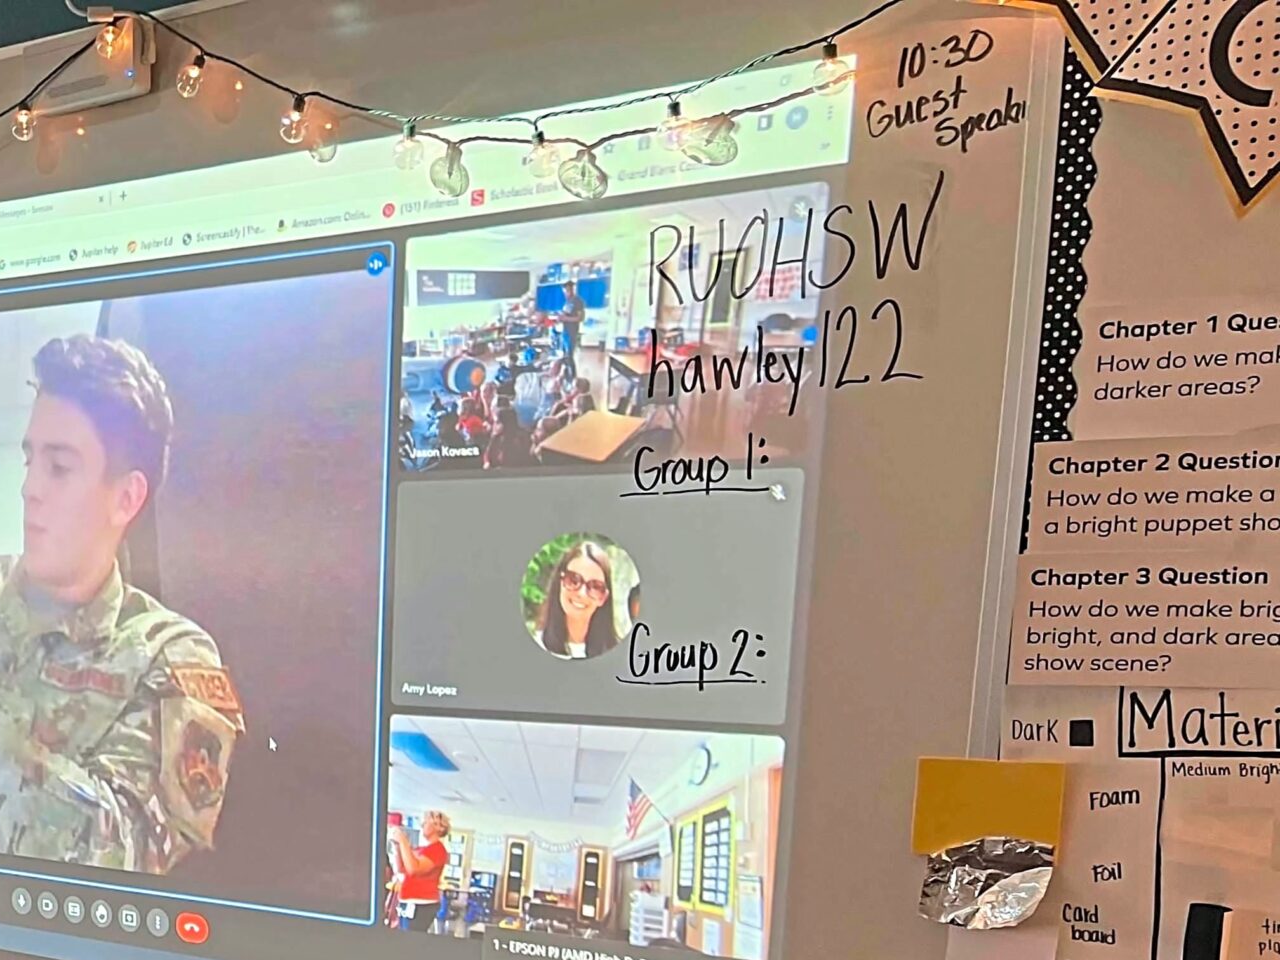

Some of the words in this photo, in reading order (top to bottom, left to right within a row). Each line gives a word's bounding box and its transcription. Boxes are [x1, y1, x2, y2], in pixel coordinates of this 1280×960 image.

[897, 28, 995, 88] 10:30
[866, 75, 968, 138] Guest
[648, 170, 945, 306] RUOHSW
[1099, 319, 1198, 341] Chapter
[1206, 315, 1218, 333] 1
[1227, 313, 1280, 333] Que
[1097, 354, 1151, 372] How
[1156, 351, 1187, 369] do
[1194, 352, 1228, 367] we
[1094, 380, 1173, 401] darker
[1178, 375, 1261, 397] areas?
[633, 446, 730, 495] Group
[745, 432, 770, 480] 1:
[1048, 455, 1148, 478] Chapter
[1155, 453, 1170, 471] 2
[1046, 489, 1102, 508] How
[1107, 487, 1138, 506] do
[1144, 491, 1179, 504] we
[1185, 484, 1253, 504] make
[1259, 488, 1276, 502] a
[1044, 520, 1059, 535] a
[1066, 515, 1138, 538] bright
[1144, 514, 1234, 537] puppet
[1030, 568, 1129, 590] Chapter
[1135, 567, 1151, 585] 3
[1158, 566, 1269, 586] Question
[1029, 600, 1082, 618] How
[1088, 599, 1118, 618] do
[1125, 603, 1160, 618] we
[1166, 599, 1233, 618] make
[1026, 626, 1103, 648] bright,
[1110, 626, 1157, 645] and
[1163, 626, 1219, 646] dark
[629, 621, 719, 691] Group
[728, 628, 768, 679] 2:
[1023, 653, 1085, 671] show
[1090, 654, 1173, 673] scene?
[402, 682, 424, 698] Amy
[426, 684, 458, 698] Lopez
[1171, 761, 1231, 778] Medium
[1238, 762, 1280, 785] Brigh
[1089, 788, 1141, 811] Foam
[1091, 862, 1123, 884] Foil
[1070, 924, 1116, 946] board
[492, 938, 500, 951] 1
[508, 940, 547, 957] EPSON
